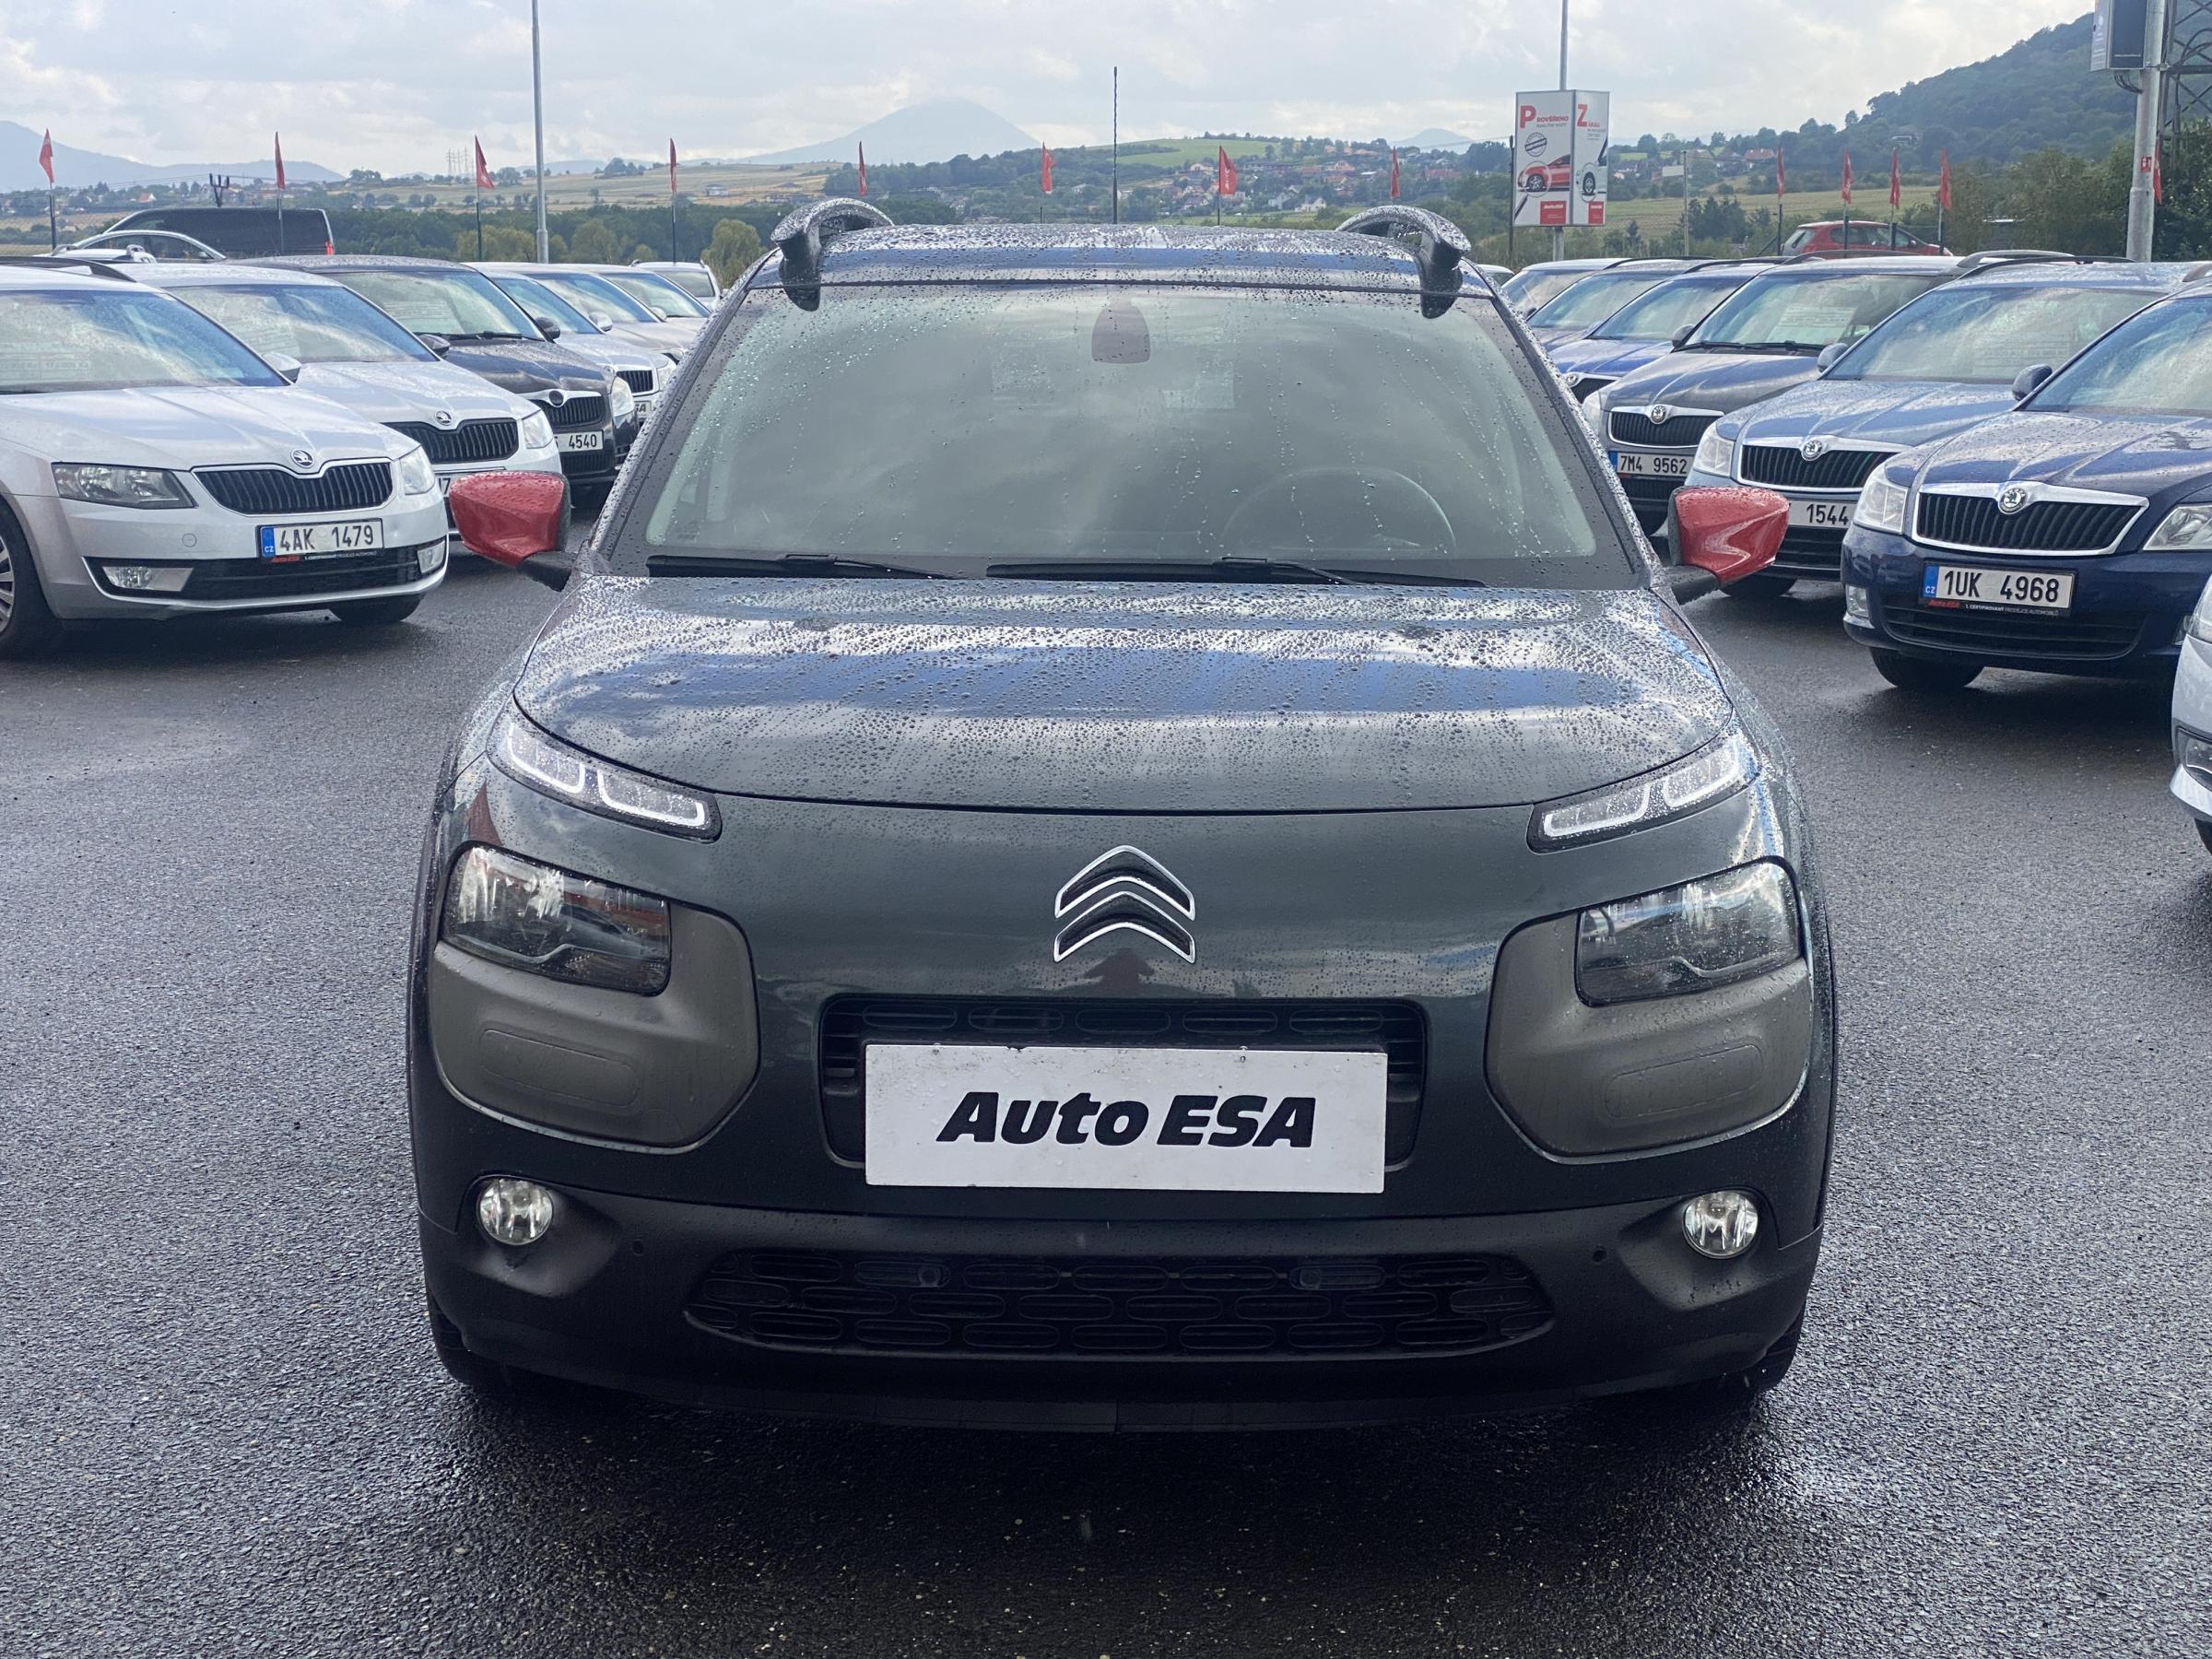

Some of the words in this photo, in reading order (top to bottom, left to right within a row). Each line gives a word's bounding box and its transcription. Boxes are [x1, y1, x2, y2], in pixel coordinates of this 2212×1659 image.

[568, 434, 597, 449] 4540
[1620, 455, 1642, 472] 7M4
[1653, 457, 1688, 475] 9562
[1806, 503, 1849, 525] 1544
[279, 527, 315, 551] 4AK
[331, 524, 374, 548] 1479
[264, 545, 275, 553] CZ
[1924, 585, 1936, 594] CZ
[1944, 570, 1983, 598] 1UK
[2000, 574, 2060, 603] 4968
[935, 1091, 1149, 1147] Auto
[1156, 1094, 1317, 1148] ESA
